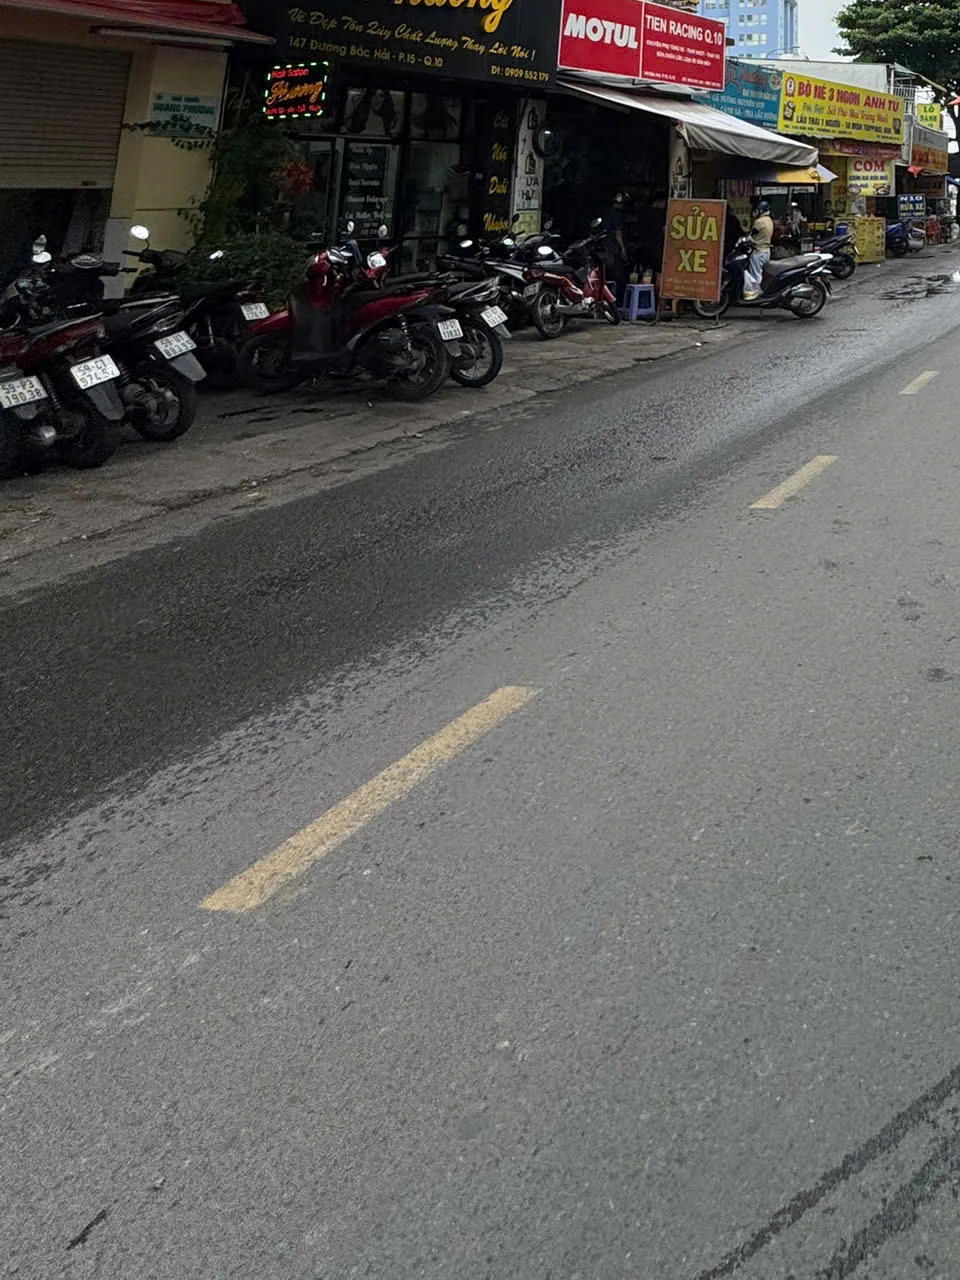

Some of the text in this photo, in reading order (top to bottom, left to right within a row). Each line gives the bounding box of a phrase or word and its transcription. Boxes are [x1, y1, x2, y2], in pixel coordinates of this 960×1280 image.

[394, 23, 424, 43] Chất
[461, 35, 485, 55] Thay
[563, 13, 639, 50] MOTUL
[669, 20, 703, 41] RACING
[704, 29, 723, 46] Q.10
[864, 95, 886, 110] ANH
[853, 158, 885, 172] CƠM
[670, 206, 719, 241] SỬA
[676, 248, 708, 273] XE
